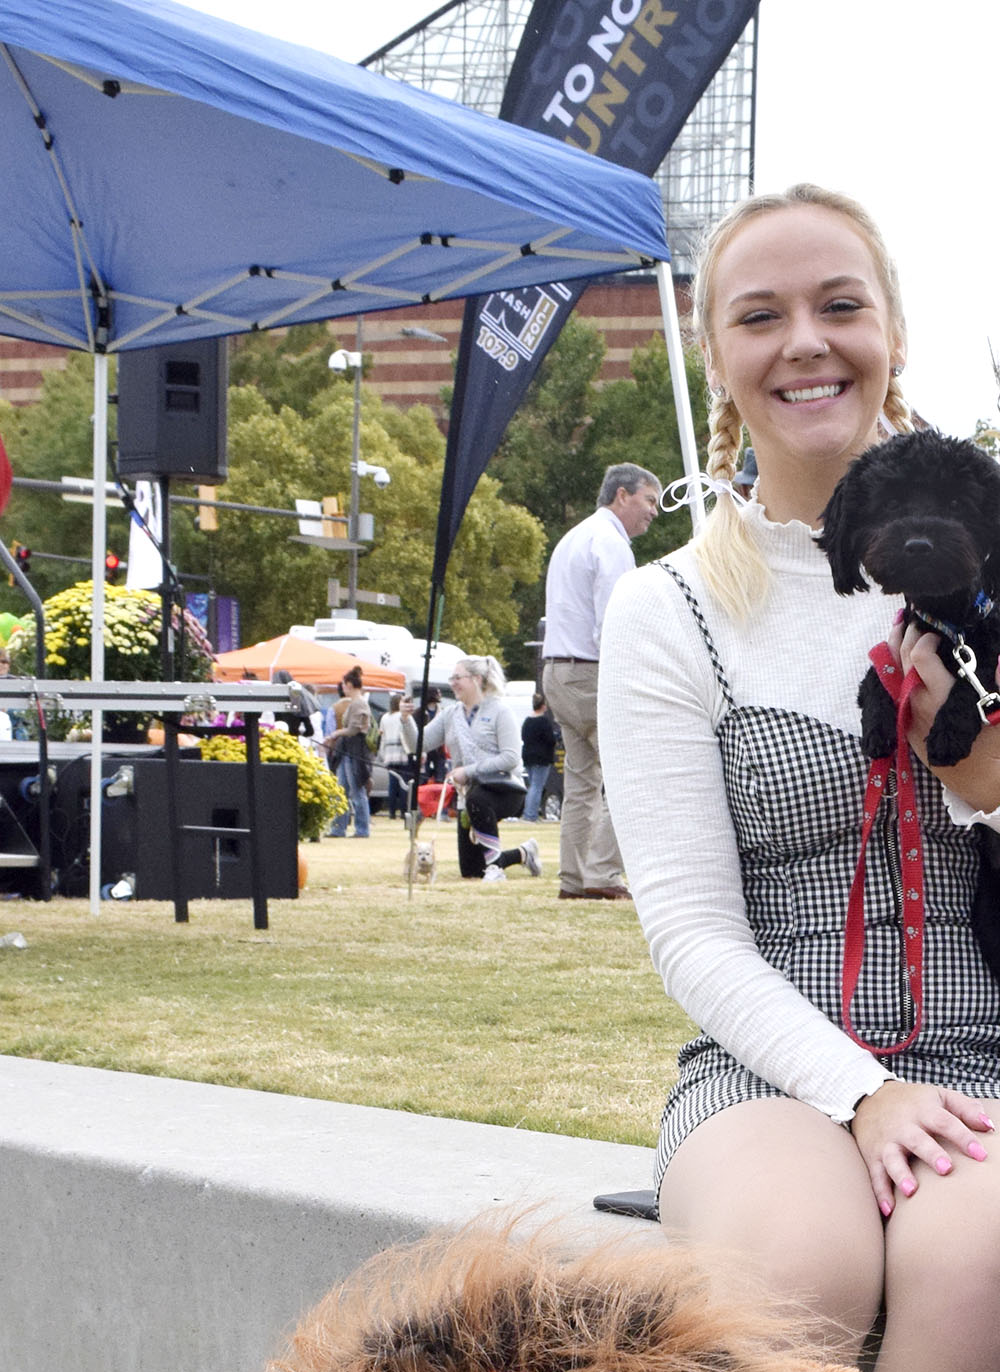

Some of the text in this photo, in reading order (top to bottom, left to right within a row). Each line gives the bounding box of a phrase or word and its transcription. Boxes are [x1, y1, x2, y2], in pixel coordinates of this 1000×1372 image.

[542, 63, 595, 128] TO
[565, 0, 680, 155] UNTR
[610, 80, 675, 159] TO
[497, 290, 531, 320] ASH
[521, 302, 551, 347] ICON
[476, 325, 519, 371] 107.9
